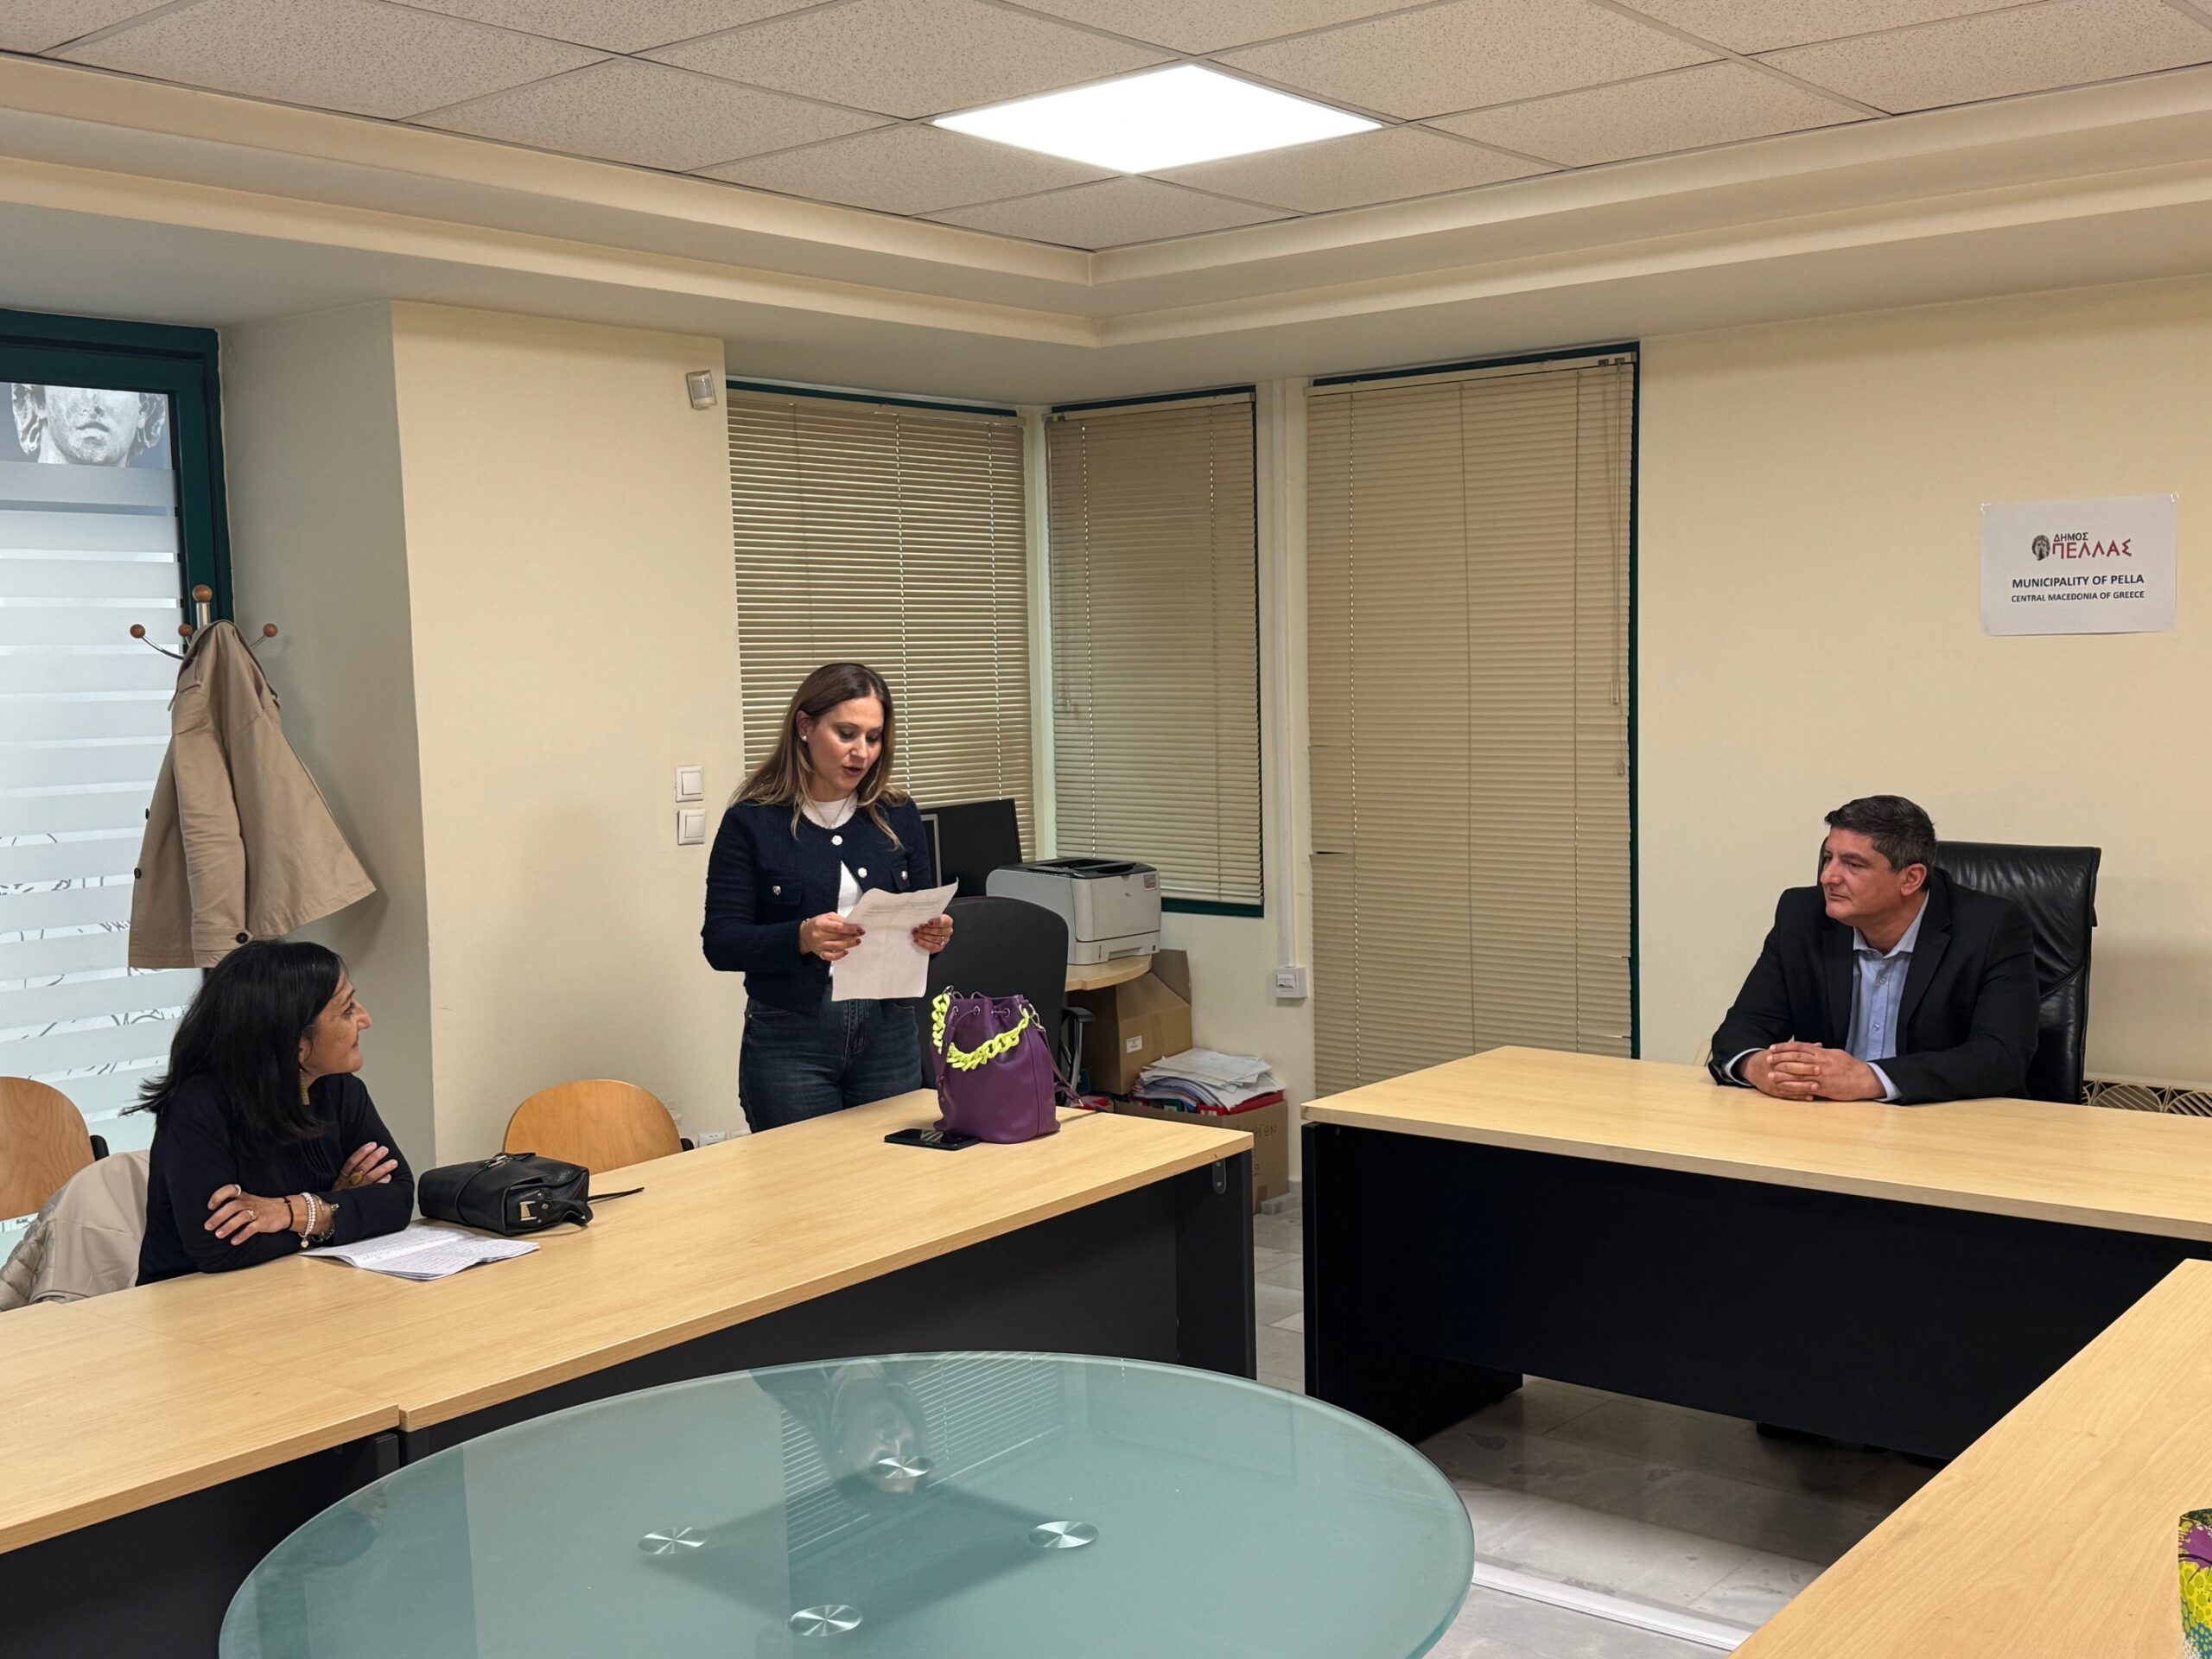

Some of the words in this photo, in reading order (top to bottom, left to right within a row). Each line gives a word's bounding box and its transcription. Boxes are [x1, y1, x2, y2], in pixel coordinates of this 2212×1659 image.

[2054, 532, 2088, 542] ΔΗΜΟΣ
[2052, 538, 2133, 560] ΠΕΛΛΑΣ
[2012, 576, 2089, 588] MUNICIPALITY
[2092, 575, 2107, 585] OF
[2111, 575, 2145, 584] PELLA
[2048, 593, 2098, 601] MACEDONIA
[2113, 591, 2145, 600] GREECE
